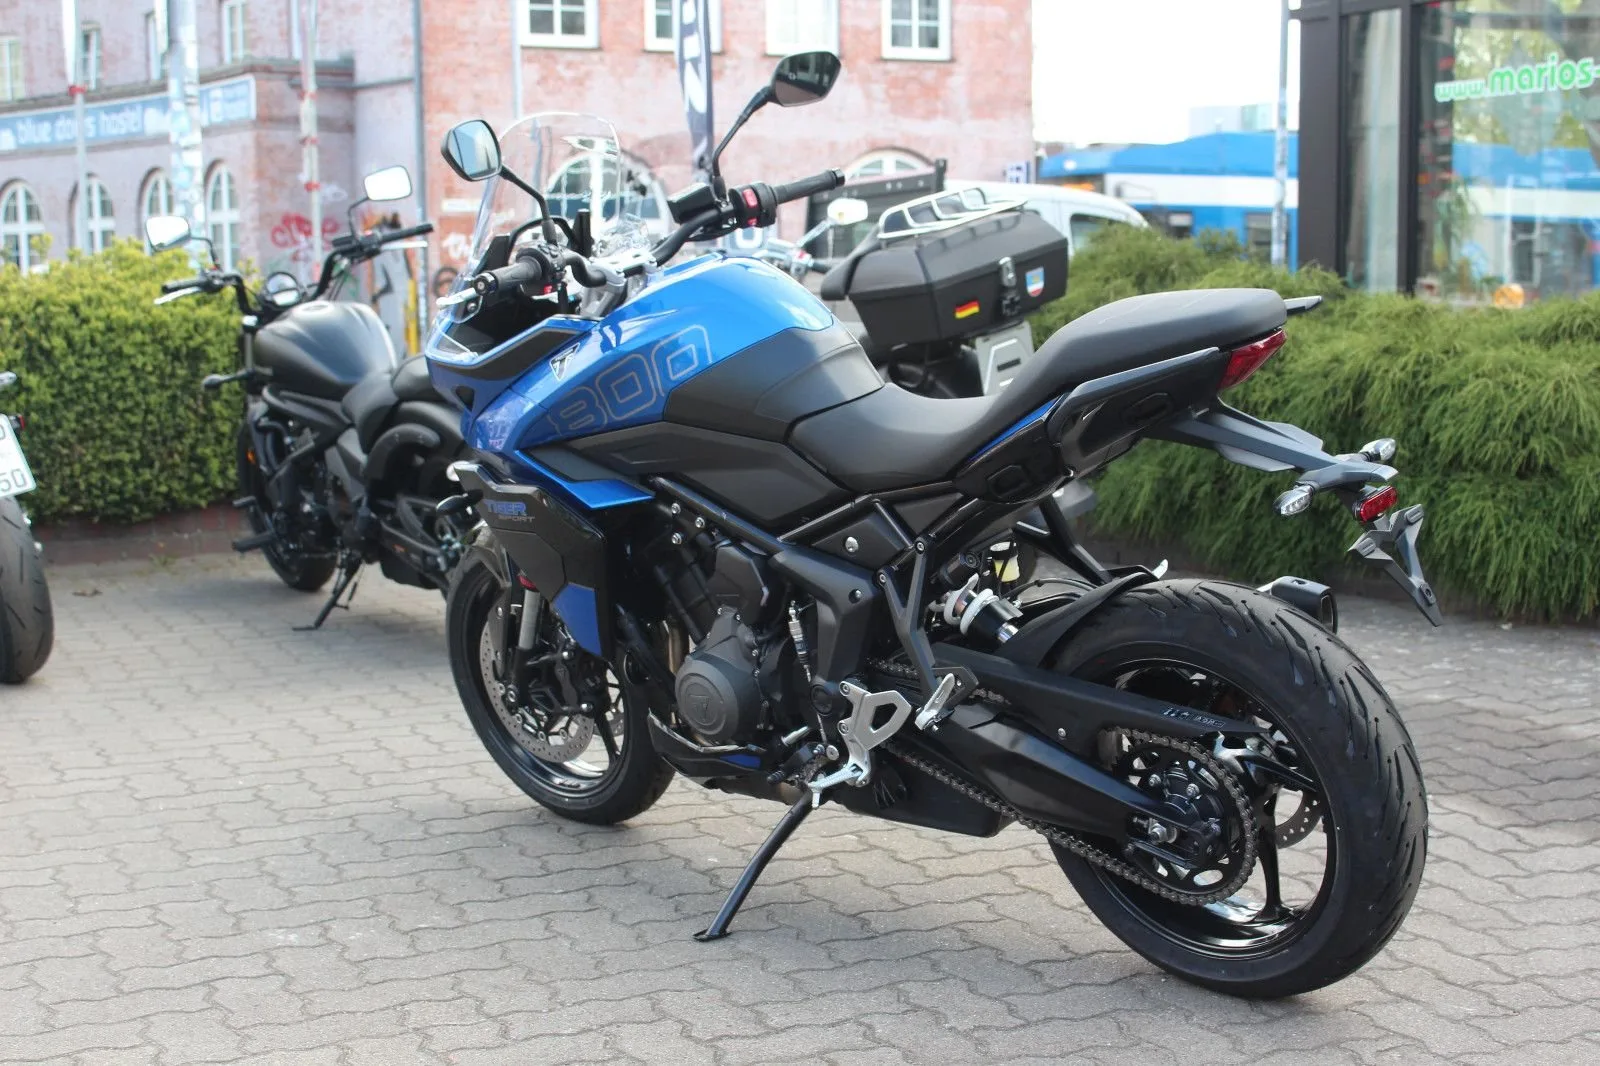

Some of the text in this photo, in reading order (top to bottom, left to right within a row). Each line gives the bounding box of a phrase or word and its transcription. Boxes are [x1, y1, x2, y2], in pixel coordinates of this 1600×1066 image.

[16, 117, 52, 145] blue
[547, 323, 713, 437] 800
[481, 499, 527, 516] TIGER
